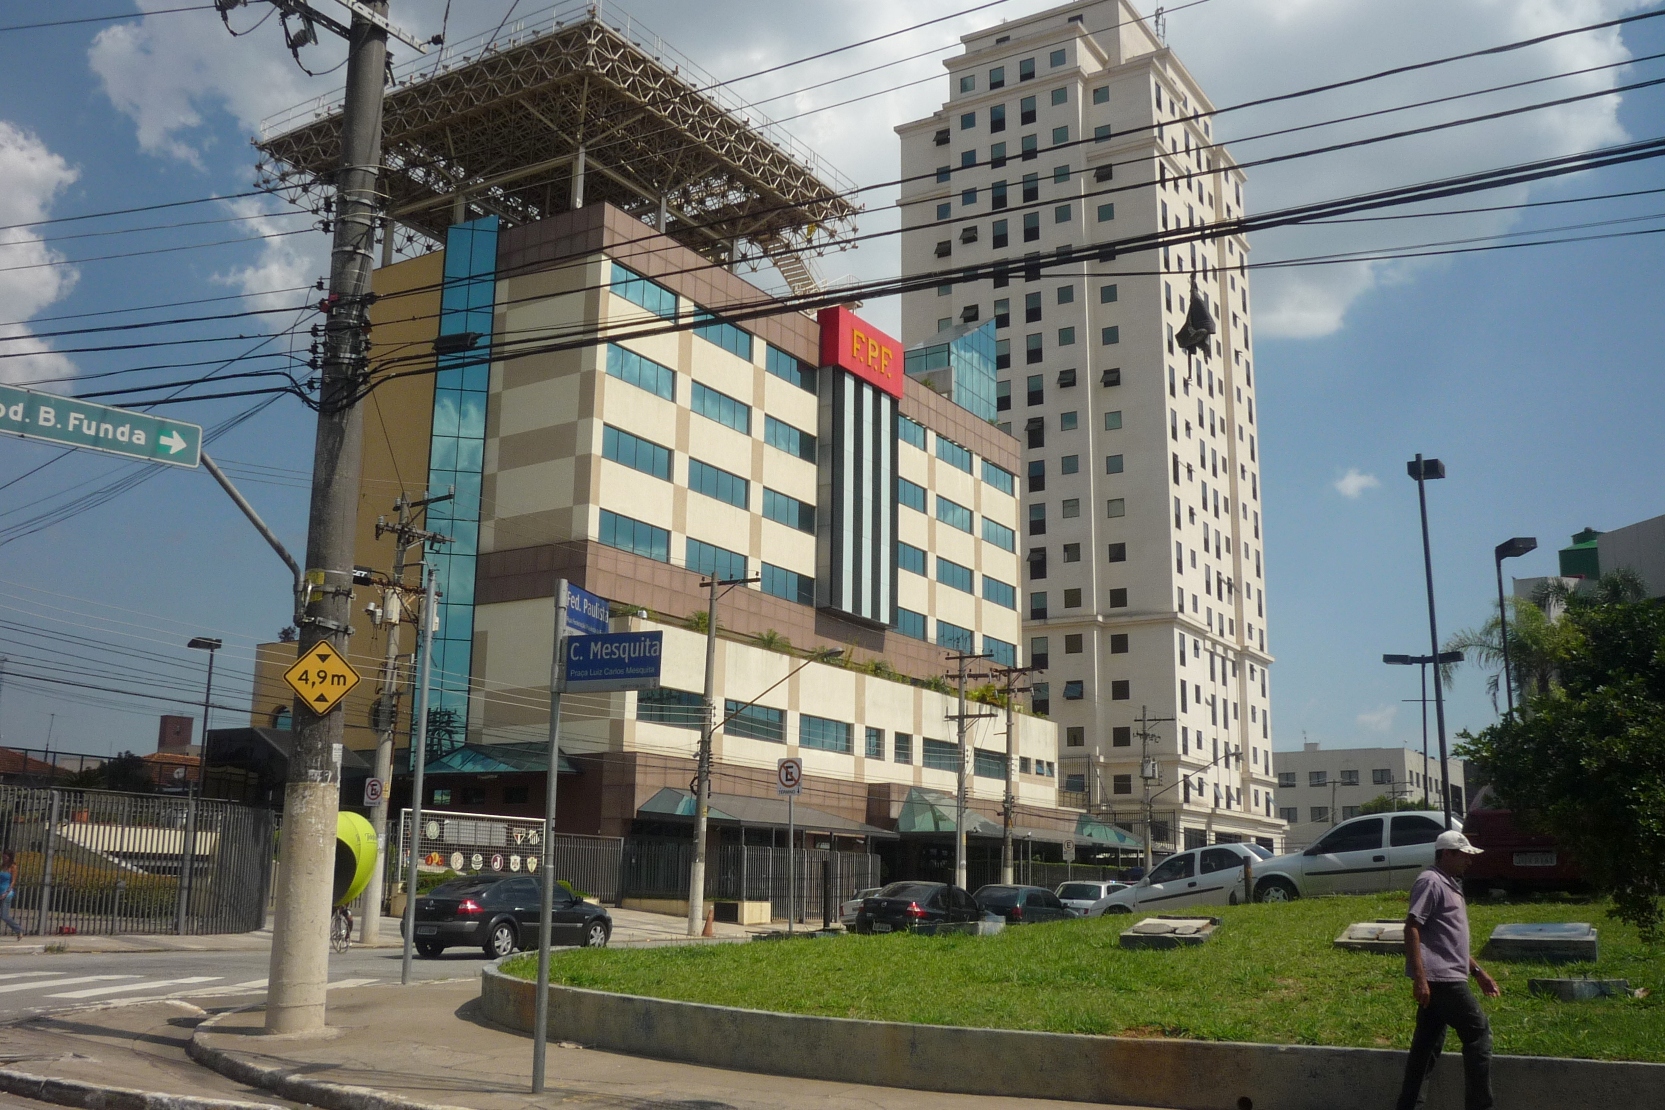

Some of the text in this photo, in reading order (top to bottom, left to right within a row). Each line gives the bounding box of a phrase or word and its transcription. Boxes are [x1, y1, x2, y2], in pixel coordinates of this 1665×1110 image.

[38, 405, 61, 429] B.
[68, 412, 146, 445] Funda
[567, 591, 609, 623] Fed. Paulista
[570, 637, 660, 663] C. Mesquita
[570, 666, 655, 678] Praça Luiz Carlos Mesquita
